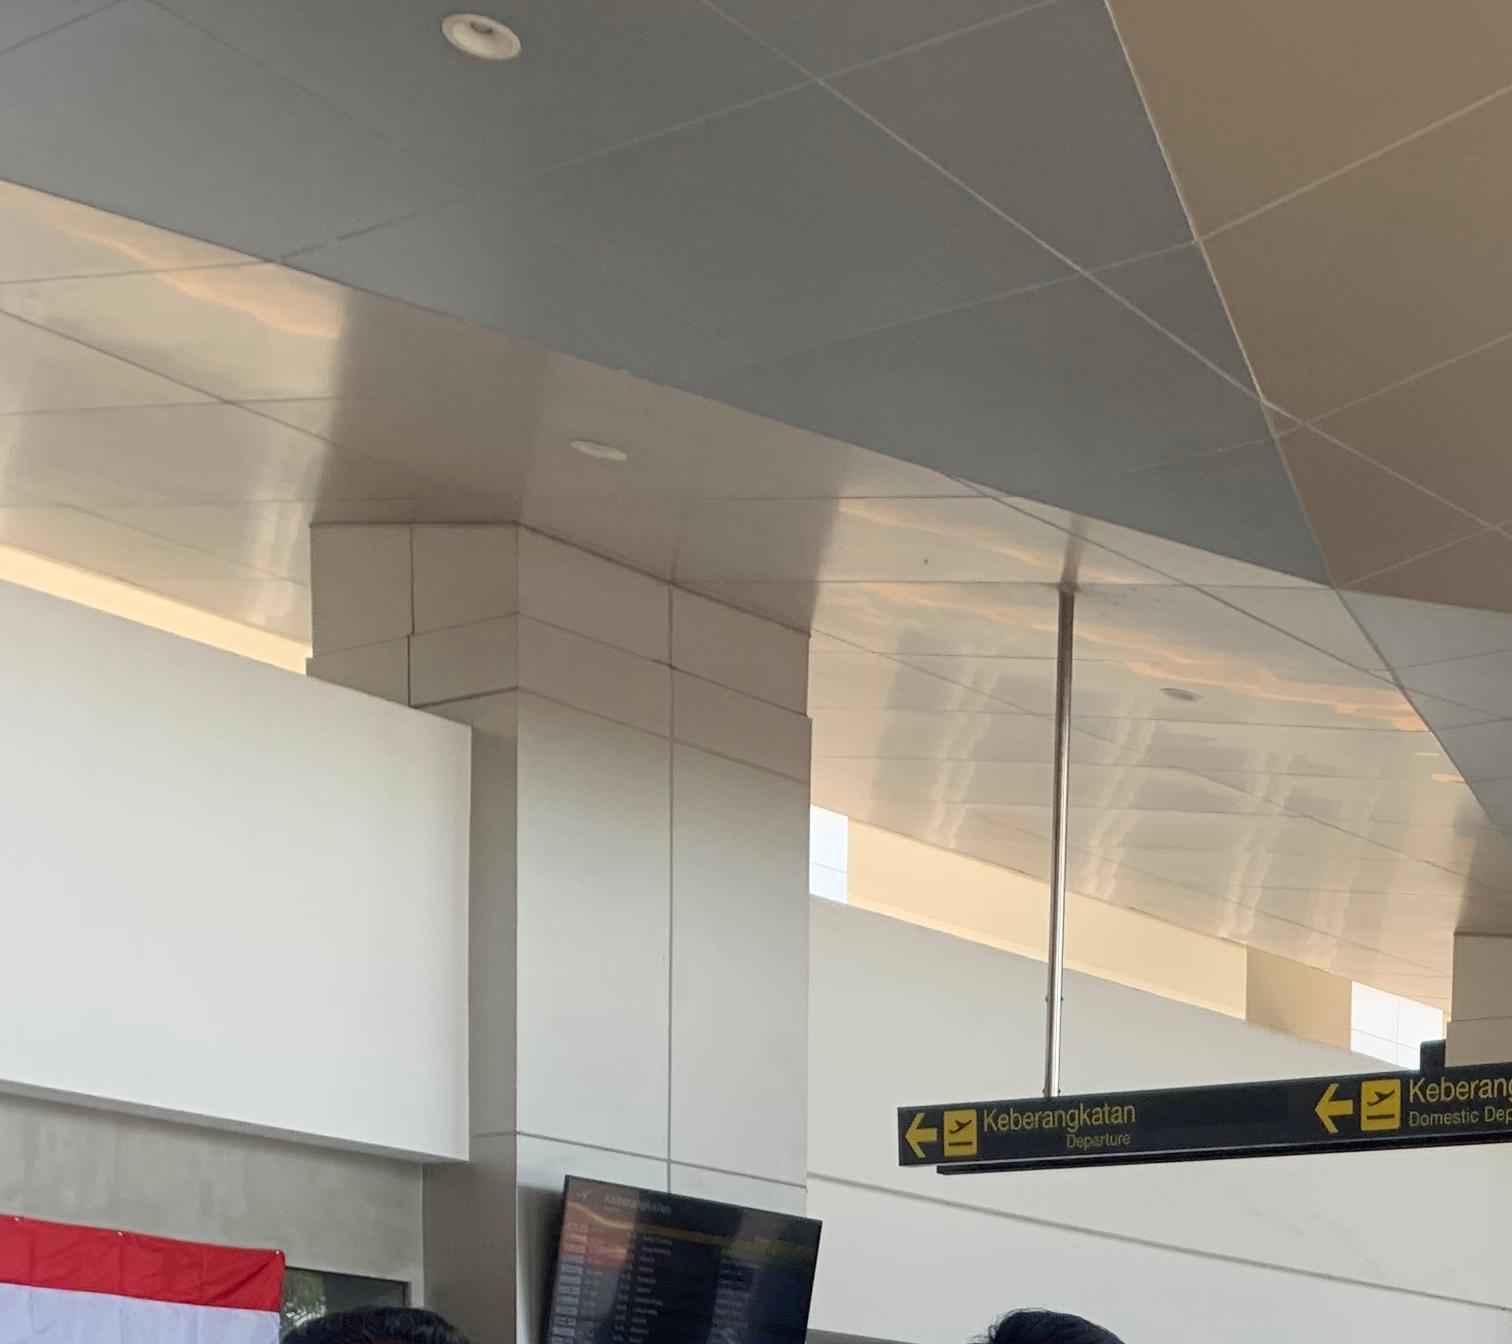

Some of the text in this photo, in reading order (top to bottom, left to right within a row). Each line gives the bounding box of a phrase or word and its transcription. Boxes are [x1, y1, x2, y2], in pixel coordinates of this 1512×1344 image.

[983, 1102, 1136, 1133] Keberangkatan
[1409, 1108, 1480, 1127] Domestic
[1066, 1132, 1131, 1149] Departure
